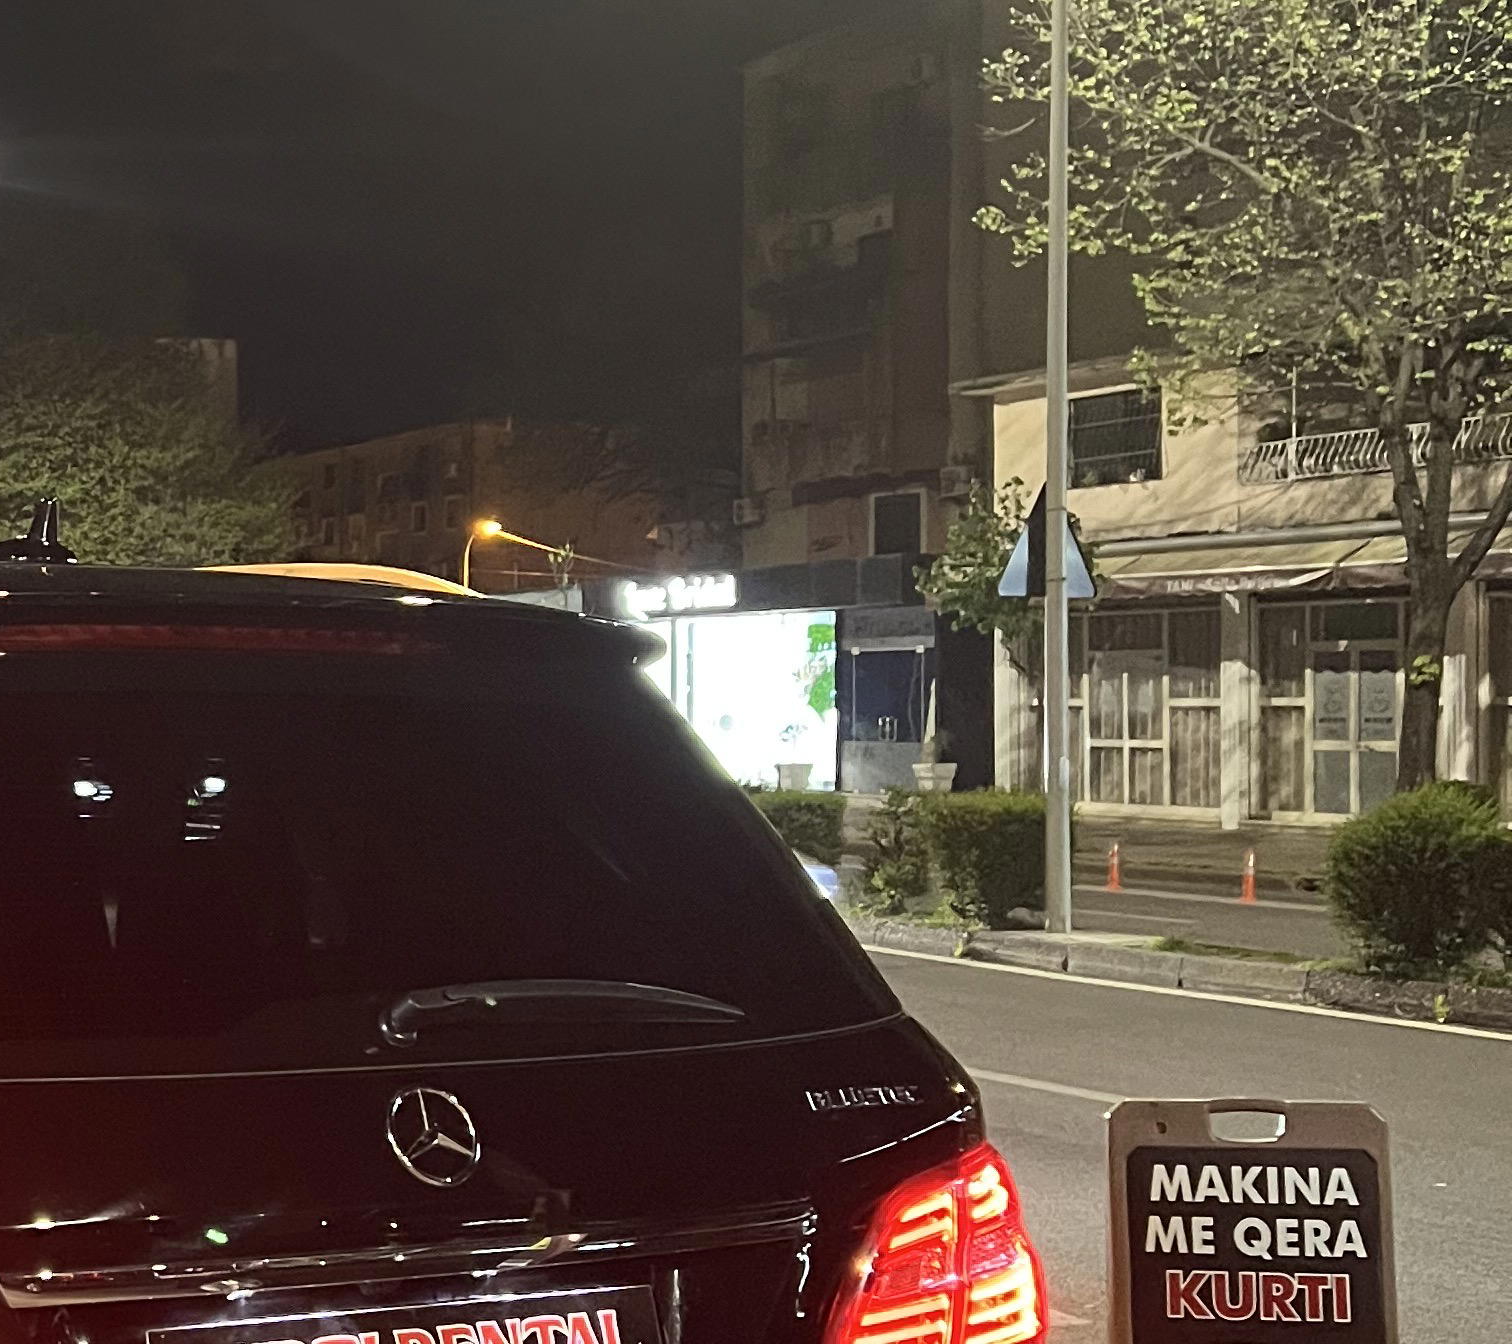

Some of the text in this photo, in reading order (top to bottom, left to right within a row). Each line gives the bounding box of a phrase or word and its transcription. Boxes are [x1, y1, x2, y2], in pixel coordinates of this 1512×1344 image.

[1150, 1164, 1360, 1206] MAKINA
[1145, 1215, 1368, 1260] ME QERA
[1165, 1269, 1352, 1323] KURTI
